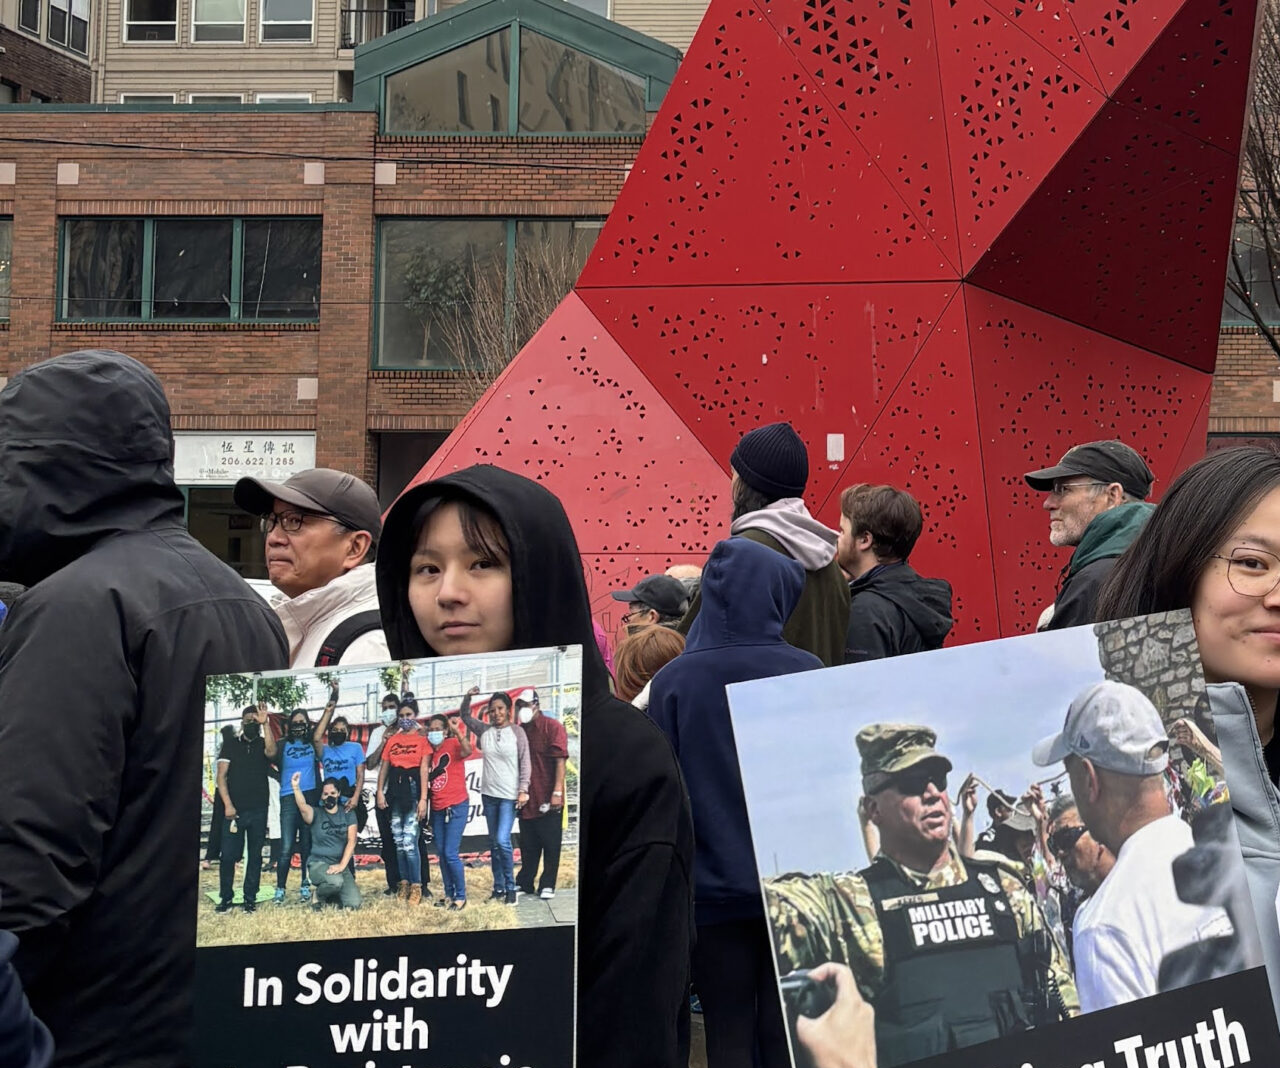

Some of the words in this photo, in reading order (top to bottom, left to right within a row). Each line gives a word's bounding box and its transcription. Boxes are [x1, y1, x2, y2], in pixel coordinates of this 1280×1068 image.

[908, 897, 986, 923] MILITARY
[912, 914, 994, 947] POLICE
[243, 966, 283, 1008] In
[294, 953, 514, 1008] Solidarity
[329, 1006, 429, 1053] with
